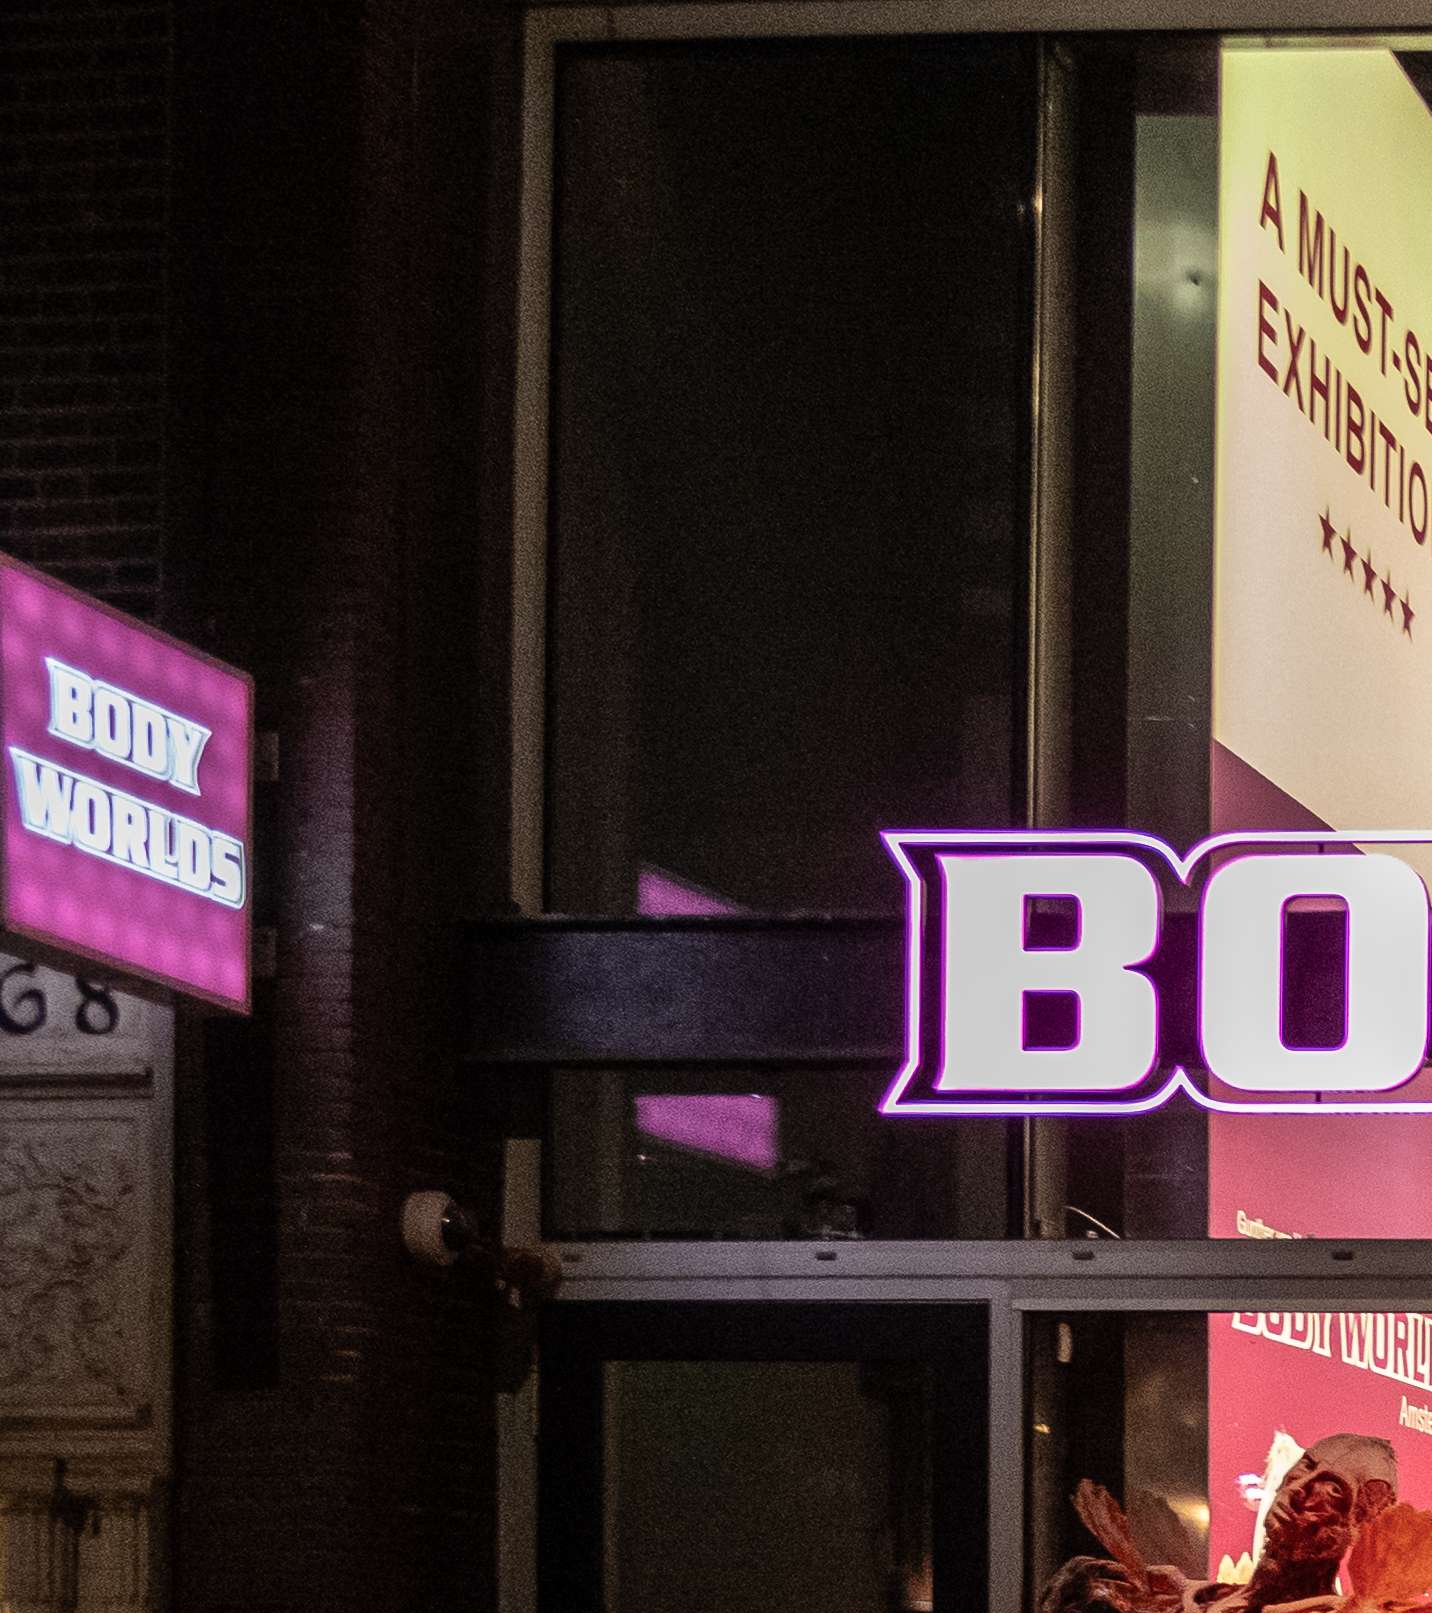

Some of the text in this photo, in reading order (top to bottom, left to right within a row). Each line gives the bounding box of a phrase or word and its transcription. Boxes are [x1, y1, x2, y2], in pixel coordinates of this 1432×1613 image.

[1259, 150, 1285, 254] A
[46, 657, 212, 796] BODY
[9, 747, 246, 909] WORLDS
